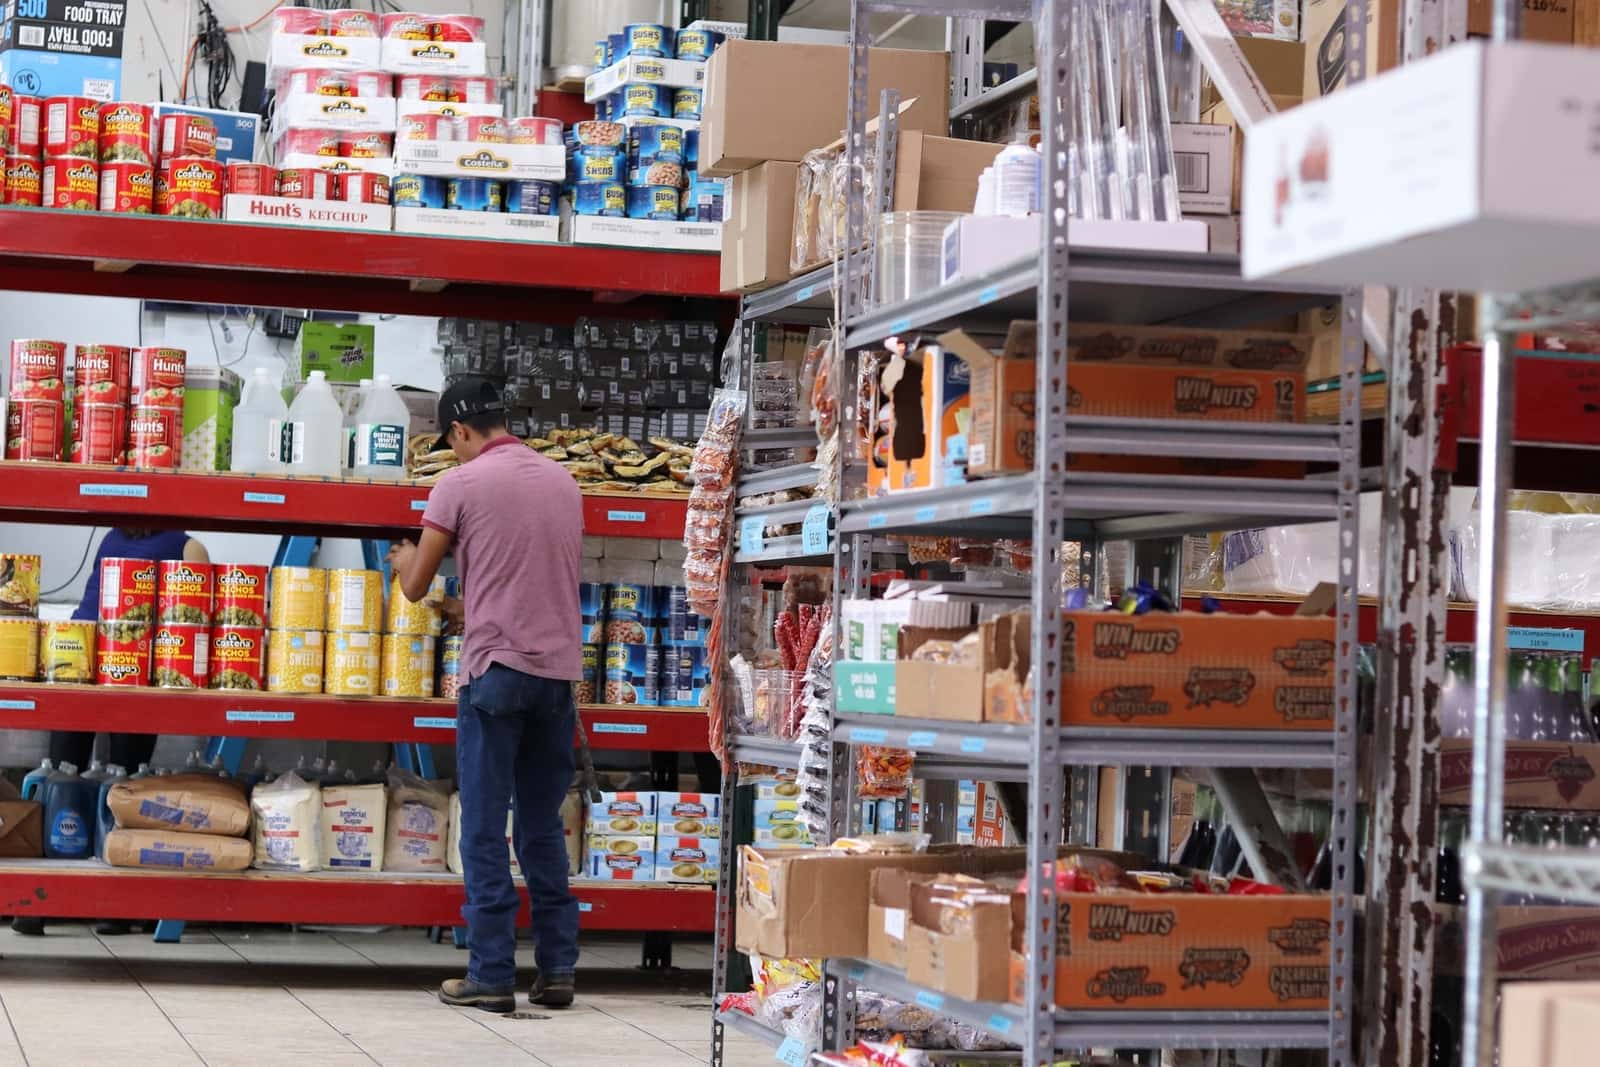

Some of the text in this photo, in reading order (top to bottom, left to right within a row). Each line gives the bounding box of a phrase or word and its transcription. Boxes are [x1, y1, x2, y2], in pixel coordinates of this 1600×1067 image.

[64, 6, 123, 26] FOOD TRAY
[48, 26, 79, 44] TRAY
[82, 29, 113, 48] FOOD
[636, 65, 664, 76] BUSH'S
[177, 181, 212, 189] NACHOS
[250, 201, 368, 223] Hunt's KETCHUP
[1176, 377, 1256, 407] WIN NUTS
[1275, 380, 1294, 400] 12
[166, 583, 202, 593] NACHOS
[220, 586, 254, 594] NACHOS
[1095, 623, 1133, 647] WIN
[1132, 630, 1178, 653] NUTS
[216, 649, 250, 657] NACHOS
[1090, 904, 1174, 934] WIN NUTS
